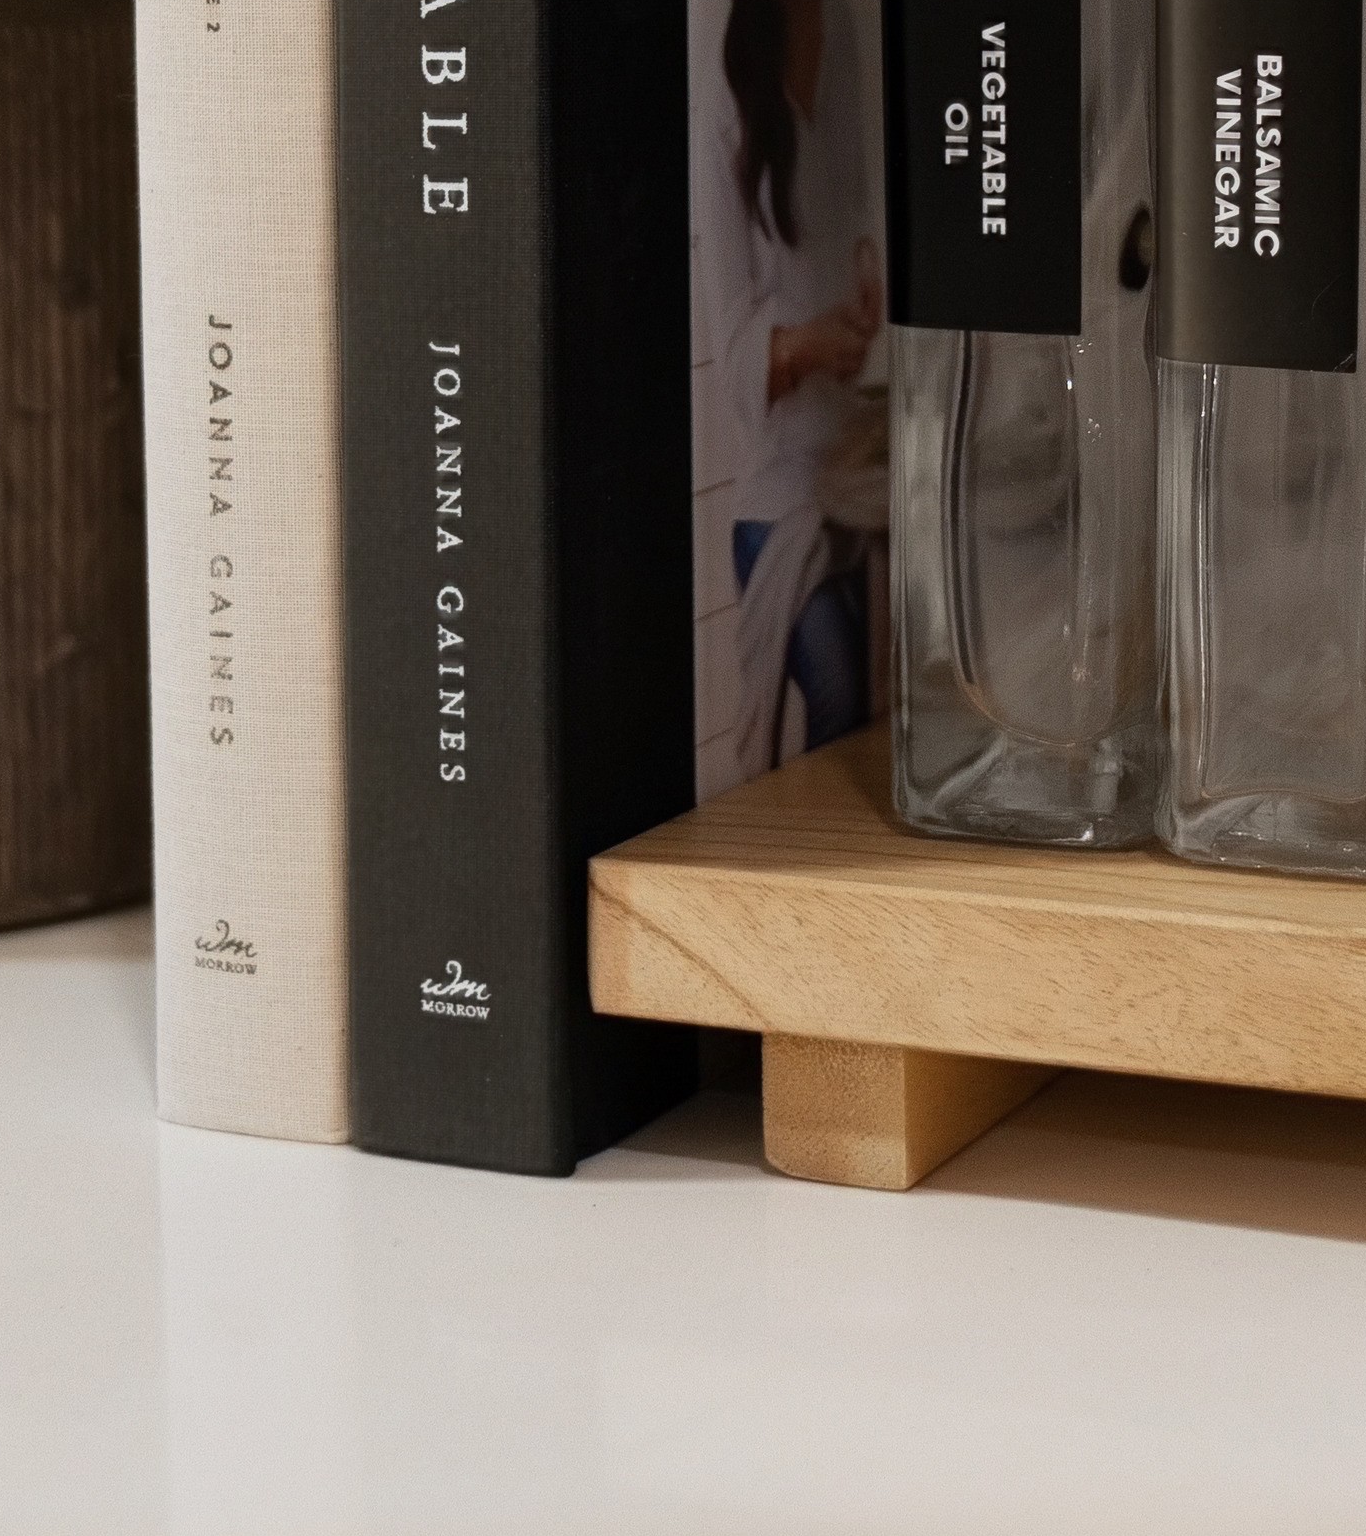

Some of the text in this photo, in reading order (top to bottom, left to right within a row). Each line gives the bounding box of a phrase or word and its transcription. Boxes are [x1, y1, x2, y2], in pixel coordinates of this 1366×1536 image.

[206, 22, 221, 33] 2
[944, 102, 970, 165] OIL
[981, 22, 1007, 235] VEGETABLE
[1214, 69, 1242, 248] VINEGAR
[1253, 54, 1283, 256] BALSAMIC
[208, 314, 235, 746] JOANNA GAINES
[429, 342, 466, 782] JOANNA GAINES
[195, 956, 258, 976] MORROW
[420, 998, 491, 1021] MORROW
